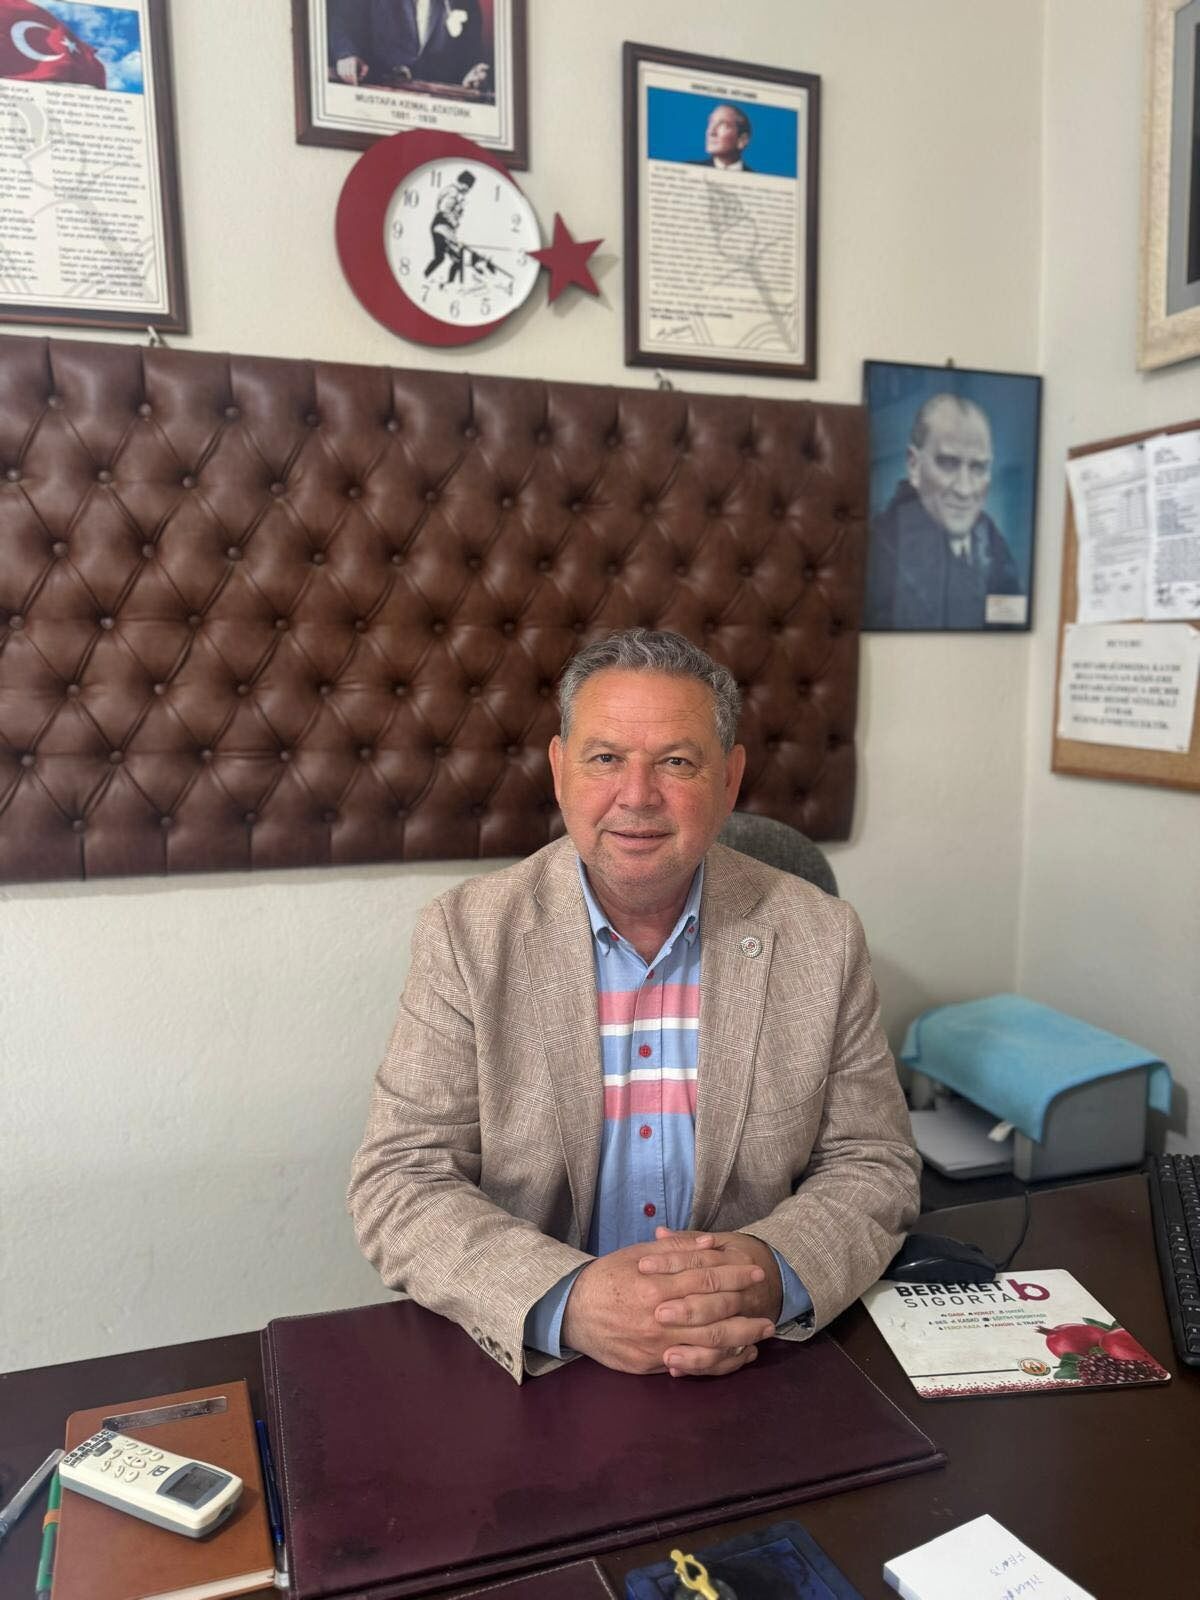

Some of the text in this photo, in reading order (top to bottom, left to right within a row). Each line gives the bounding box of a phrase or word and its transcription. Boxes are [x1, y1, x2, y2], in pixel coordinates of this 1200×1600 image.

[430, 170, 442, 188] 11
[404, 189, 419, 209] 10
[495, 185, 501, 202] 1
[393, 220, 404, 240] 9
[400, 257, 411, 276] 8
[421, 284, 430, 302] 7
[450, 300, 461, 319] 6
[481, 297, 492, 316] 5
[894, 1281, 1004, 1297] BEREKET
